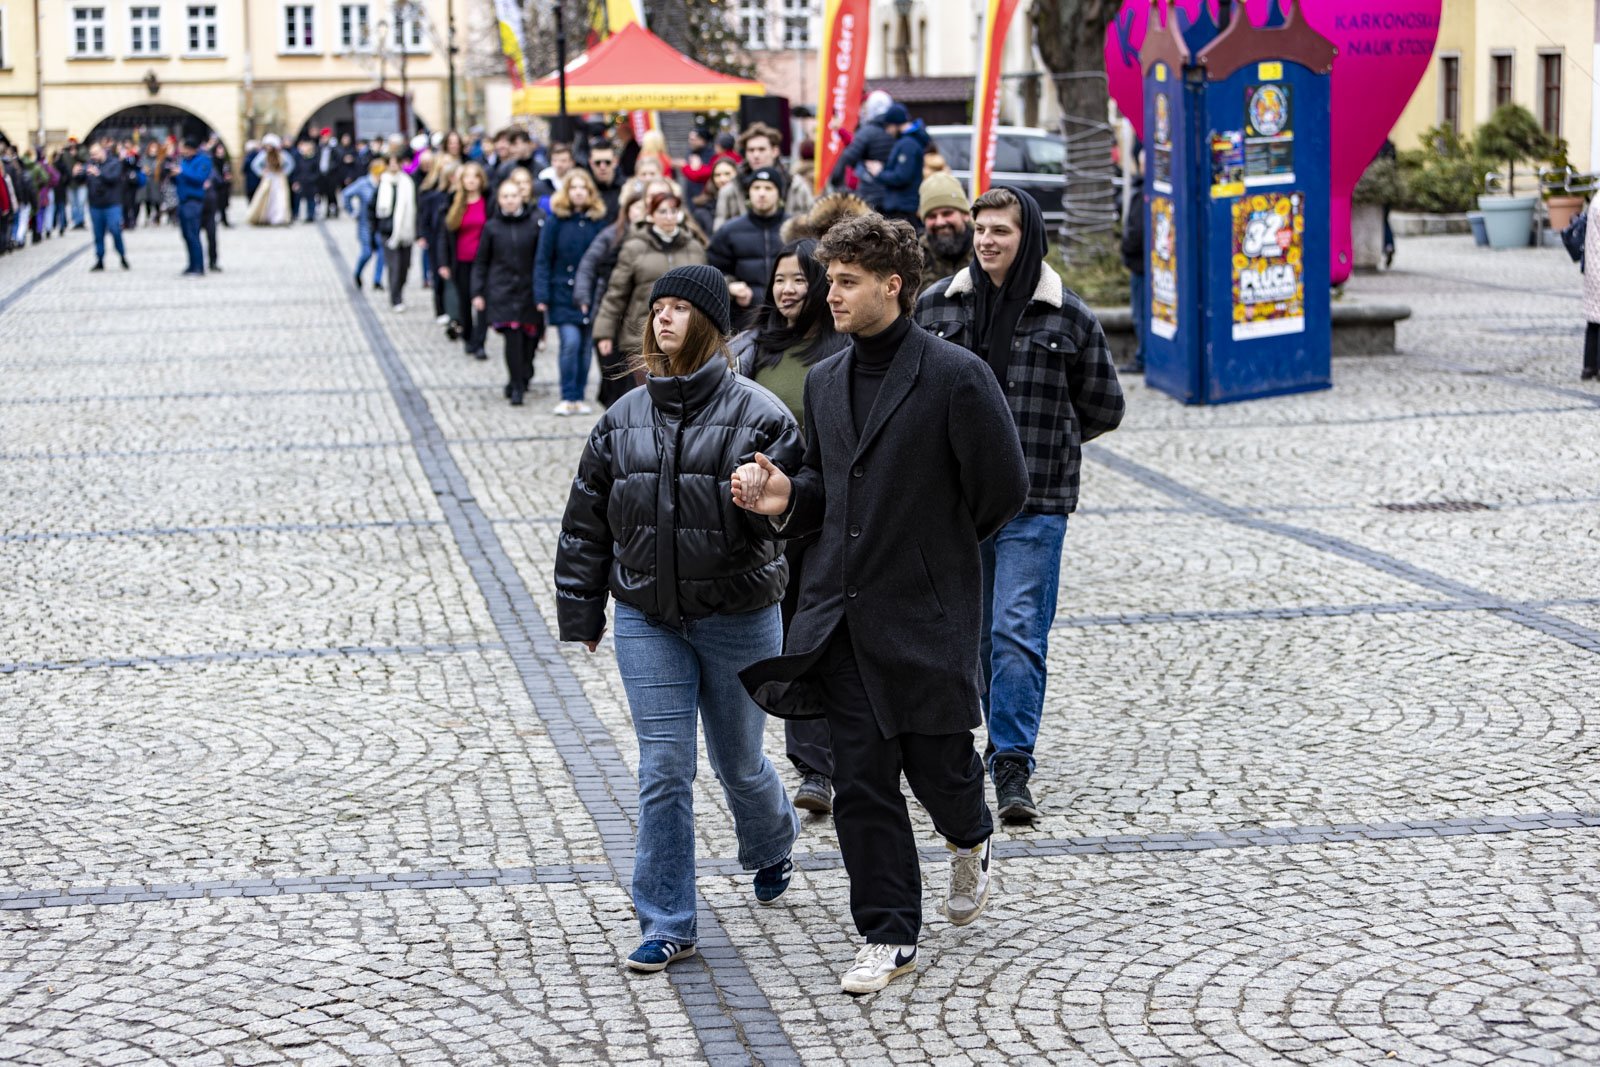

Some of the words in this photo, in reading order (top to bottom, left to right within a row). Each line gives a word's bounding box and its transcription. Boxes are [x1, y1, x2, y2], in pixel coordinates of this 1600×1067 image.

[835, 14, 855, 72] Góra
[1347, 39, 1392, 56] NAUK
[1243, 213, 1284, 257] 32
